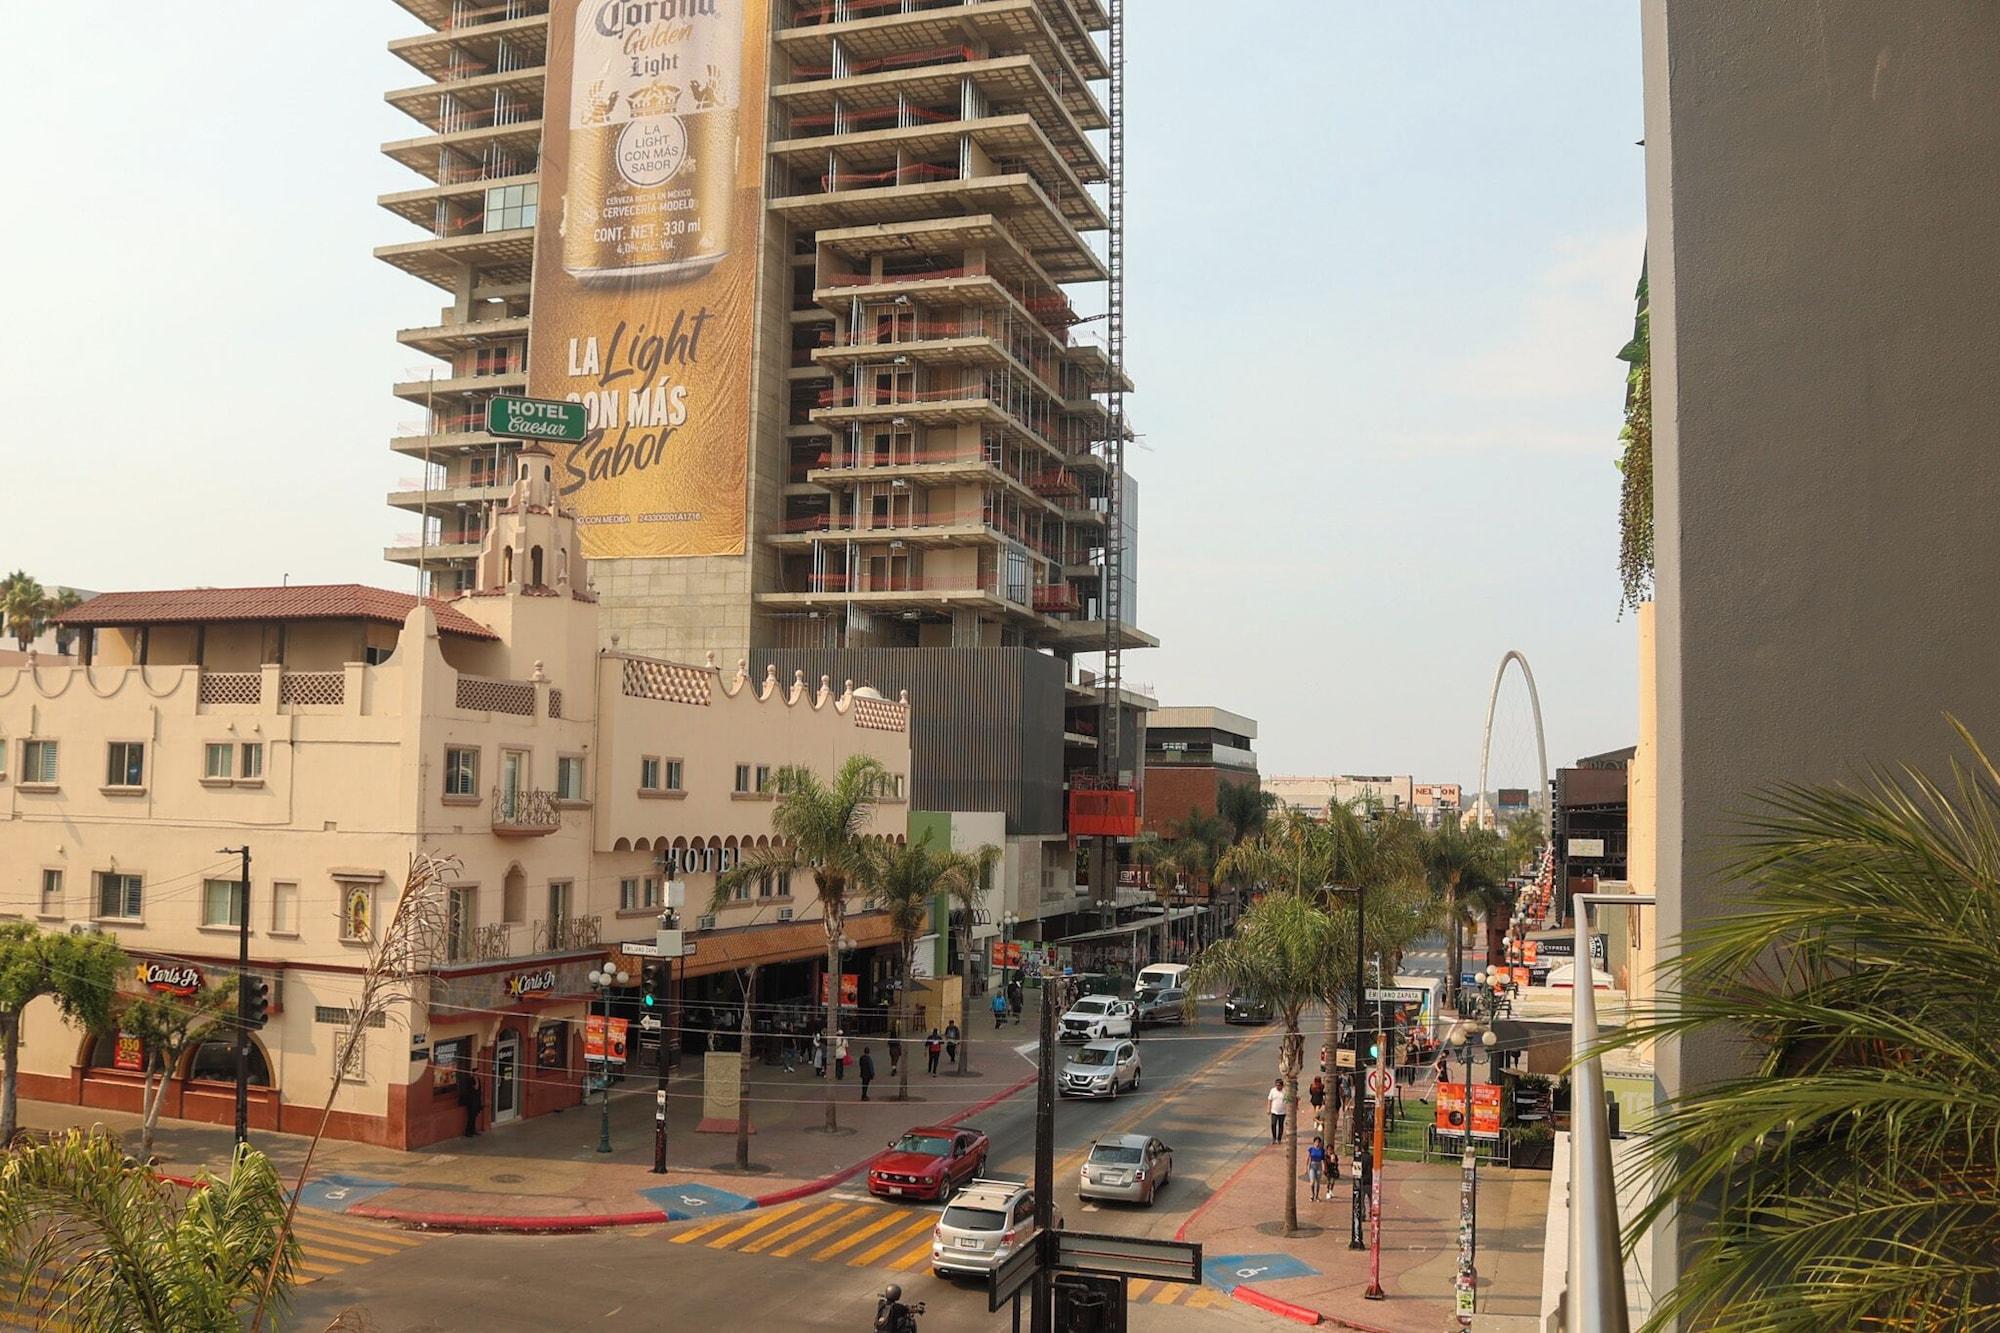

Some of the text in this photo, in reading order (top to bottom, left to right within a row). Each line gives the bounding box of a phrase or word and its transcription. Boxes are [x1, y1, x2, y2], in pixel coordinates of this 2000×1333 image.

[594, 0, 716, 39] Corona
[623, 22, 694, 55] Golden
[630, 53, 679, 77] Light
[644, 124, 661, 135] LA
[635, 135, 669, 148] LIGHT
[624, 144, 679, 162] CON MÁS
[631, 160, 671, 173] SABOR
[606, 195, 634, 206] CERVEZA
[659, 199, 694, 212] MODELO
[593, 226, 626, 242] CONT.
[663, 220, 685, 236] 330
[687, 217, 701, 232] ml
[568, 306, 715, 396] LA Light
[507, 400, 569, 420] HOTEL
[566, 376, 688, 431] ON MÁS
[508, 414, 567, 436] Caesar
[560, 421, 678, 497] Sabor
[585, 514, 602, 525] CON
[603, 513, 631, 524] MEDIDA
[1416, 788, 1456, 796] NELON
[1545, 944, 1571, 952] CYPRESS
[147, 964, 181, 984] Carl's
[519, 972, 543, 994] Carl's
[1397, 991, 1419, 999] ZAPATA
